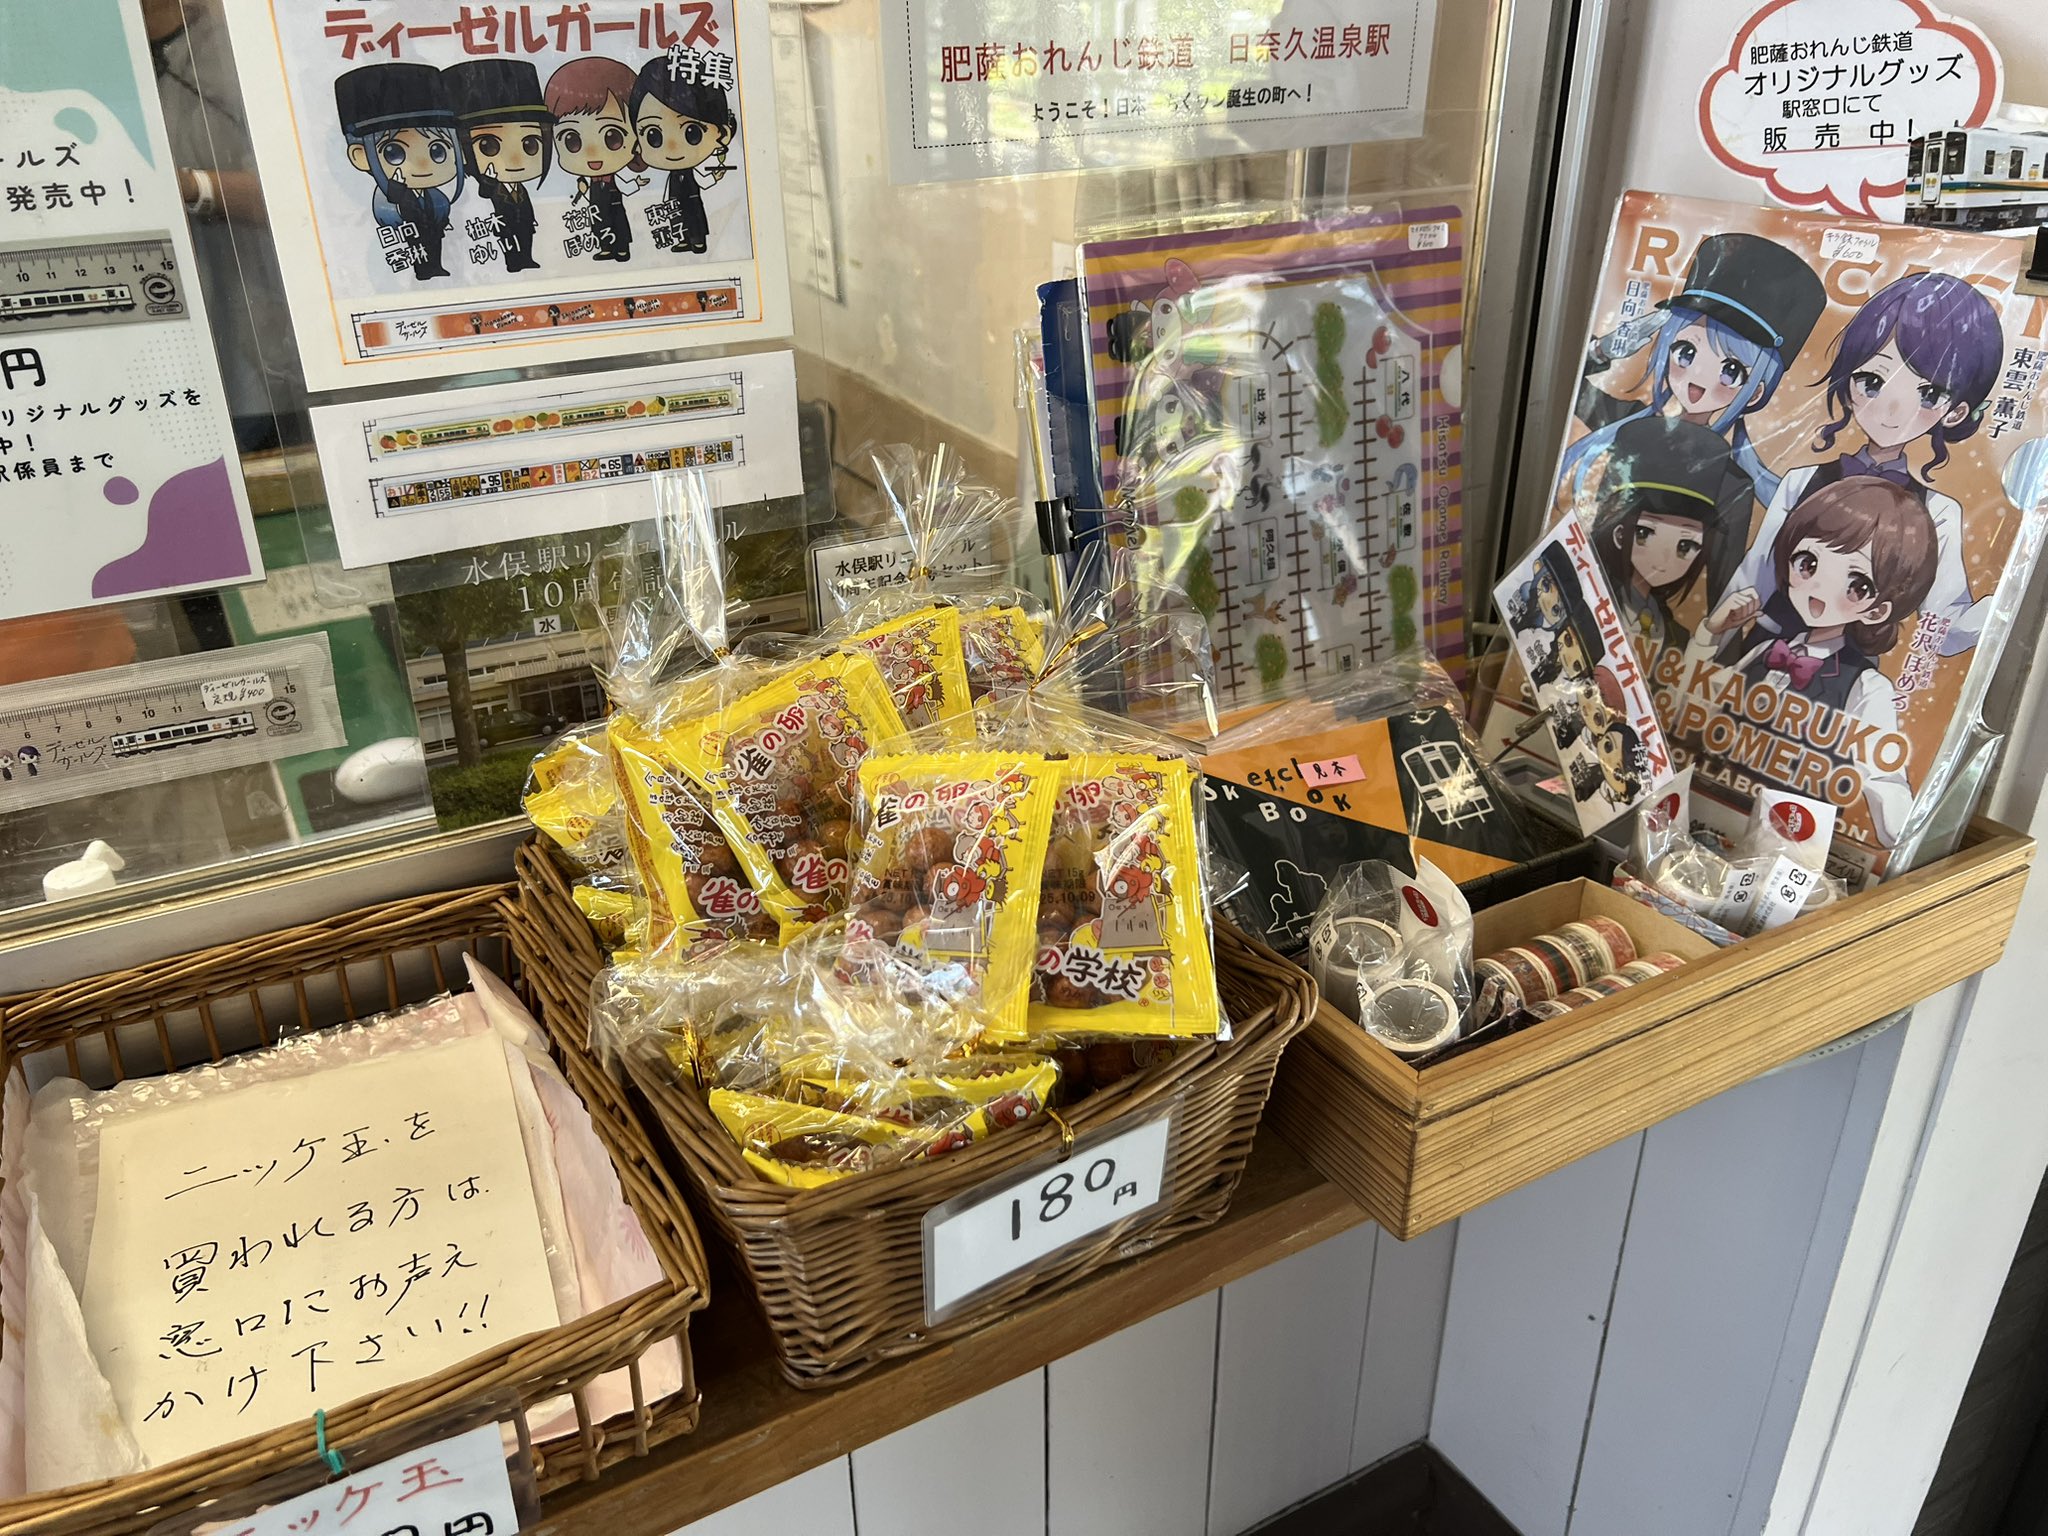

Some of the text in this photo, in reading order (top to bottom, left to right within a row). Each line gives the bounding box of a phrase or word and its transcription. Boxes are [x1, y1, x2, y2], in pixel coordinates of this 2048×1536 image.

[324, 2, 720, 60] ディーゼルガールズ
[1750, 30, 1914, 65] 肥薩おれんじ鉄道
[667, 44, 734, 91] 特集
[940, 23, 1391, 83] 肥薩おれんじ鉄道 日奈久温泉駅
[1744, 53, 1964, 96] オリジナルグッズ
[1782, 94, 1883, 120] 駅窓口にて
[0, 142, 80, 169] ルズ
[562, 204, 602, 233] 花沢
[644, 199, 683, 226] 東雲
[376, 222, 419, 249] 日向
[469, 235, 521, 265] ゆいり
[563, 227, 616, 258] ぽめろ
[16, 261, 174, 283] 10 11 12 13 14 15
[1, 347, 46, 389] 円
[2, 388, 201, 427] リジナルグッズを
[24, 730, 31, 740] 6
[55, 725, 61, 734] 7
[85, 720, 92, 729] 8
[115, 714, 122, 724] 9
[141, 708, 156, 720] 10
[171, 705, 183, 714] 11
[284, 684, 297, 694] 15
[163, 1176, 488, 1304] 買われる方は
